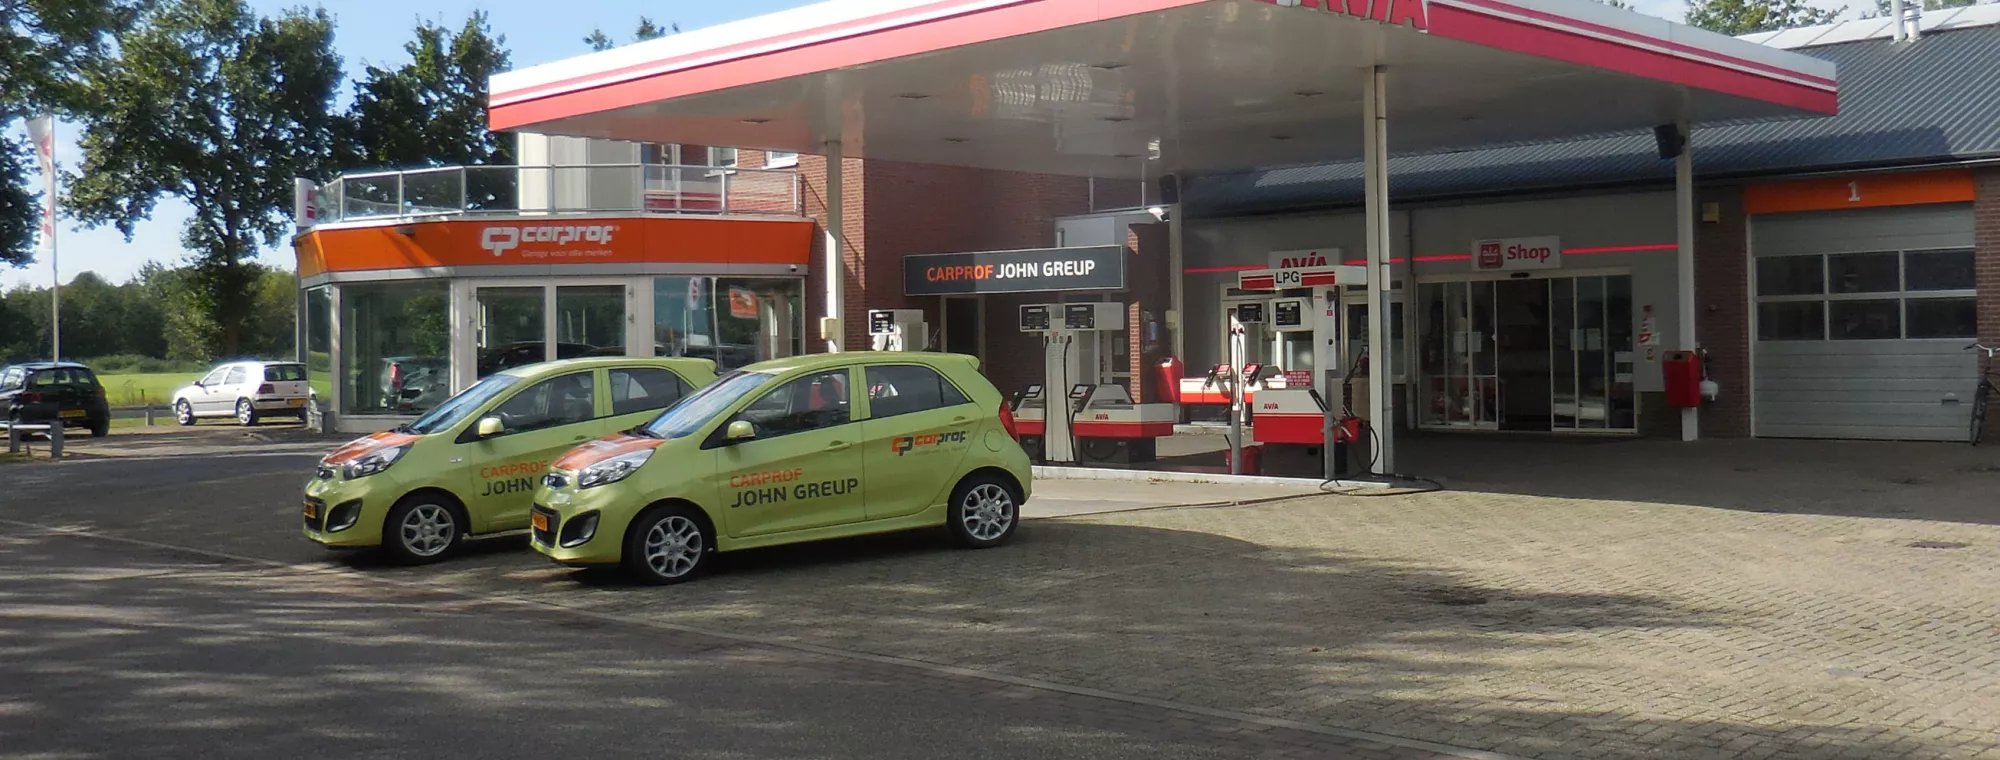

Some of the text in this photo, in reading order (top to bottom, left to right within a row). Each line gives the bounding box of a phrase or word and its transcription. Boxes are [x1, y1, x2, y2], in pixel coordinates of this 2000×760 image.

[1848, 181, 1860, 202] 1
[1507, 244, 1551, 264] Shop
[926, 259, 1095, 282] CARPROF JOHN GREUP
[1275, 270, 1300, 284] LPG
[1264, 401, 1279, 410] AVIA
[1095, 412, 1109, 420] AVIA
[480, 459, 549, 479] CARPROF
[730, 467, 803, 489] CARPROF
[482, 476, 534, 497] JOHN
[731, 477, 859, 508] JOHN GREUP
